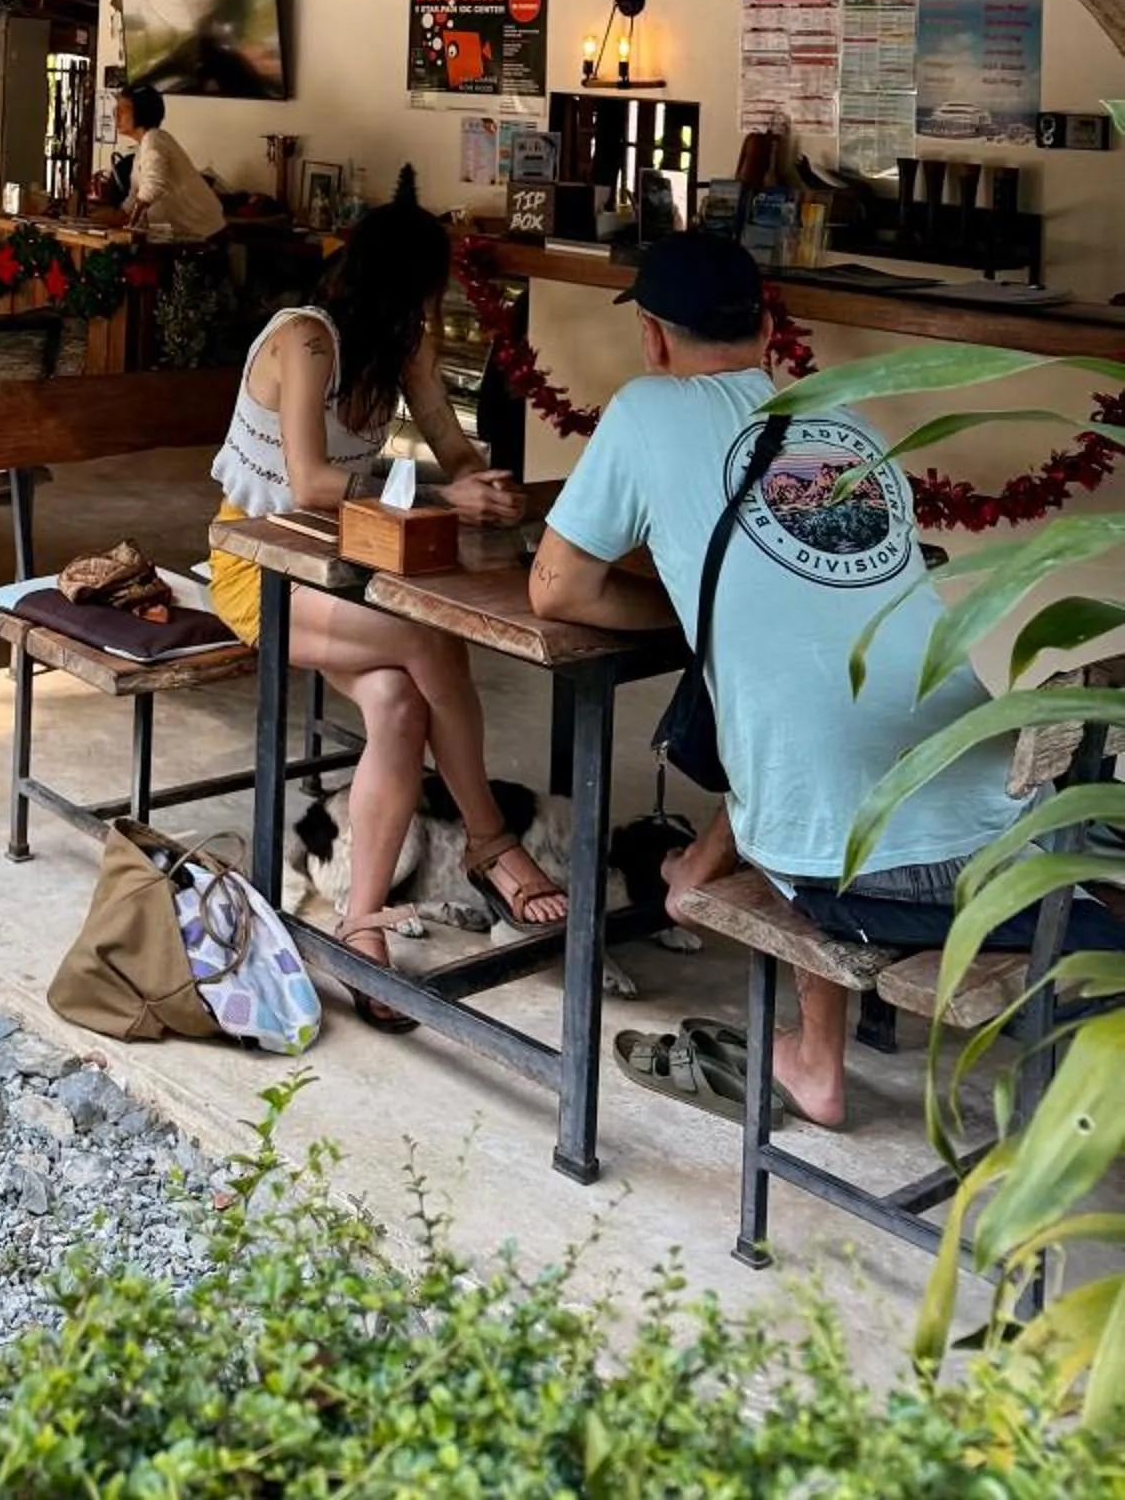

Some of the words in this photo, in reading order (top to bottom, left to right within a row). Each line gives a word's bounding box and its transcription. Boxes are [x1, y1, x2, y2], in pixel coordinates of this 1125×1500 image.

[475, 5, 505, 13] CENTER
[513, 191, 546, 210] TIP
[509, 212, 544, 231] BOX
[797, 542, 899, 575] DIVISION
